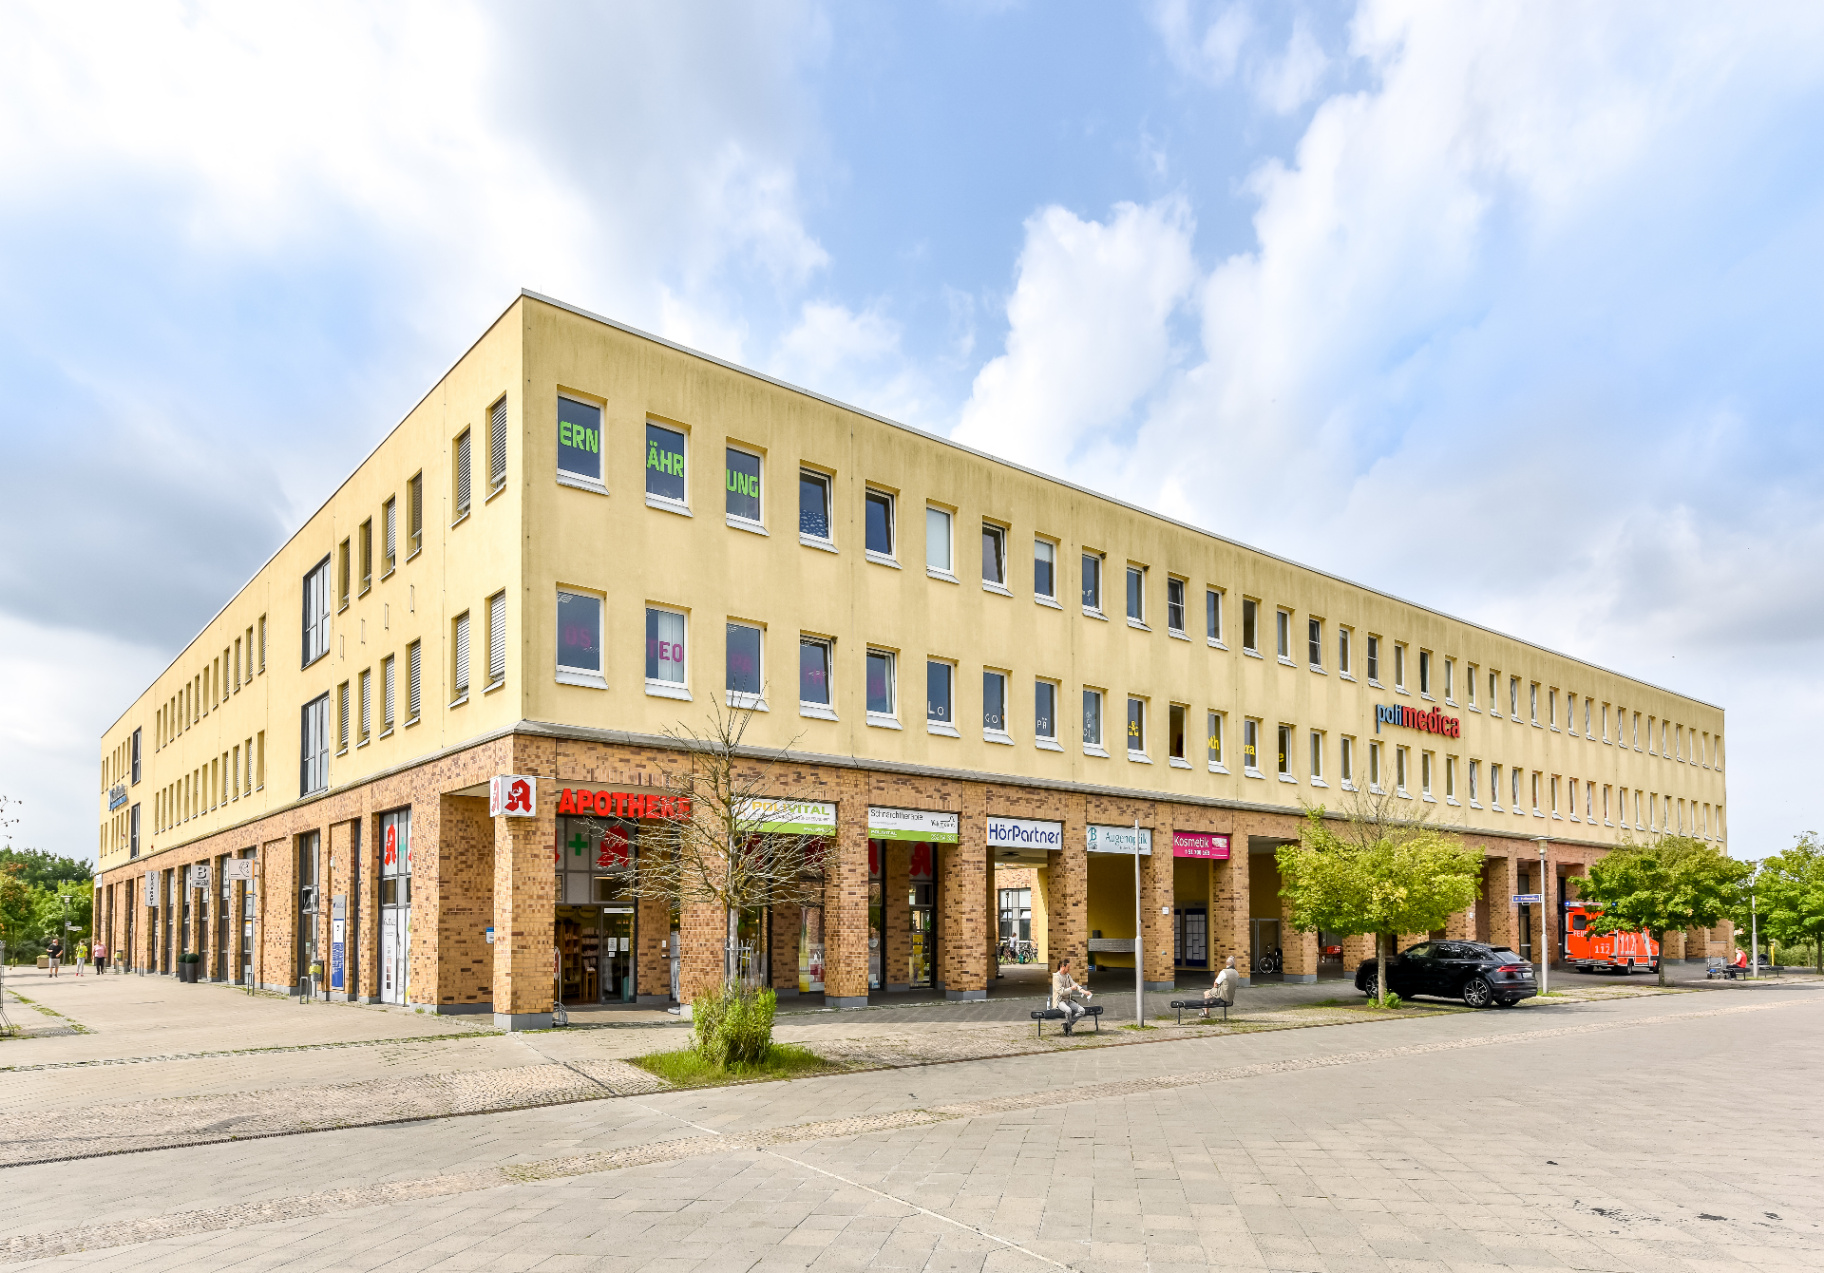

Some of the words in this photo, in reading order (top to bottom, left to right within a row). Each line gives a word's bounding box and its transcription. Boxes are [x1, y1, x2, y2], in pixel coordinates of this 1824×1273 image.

[559, 420, 599, 454] ERN
[646, 440, 684, 478] ÄHR
[726, 468, 759, 499] UNG
[1376, 704, 1460, 738] polimedica
[558, 788, 692, 821] APOTHEKE
[989, 823, 1060, 844] HörPartner
[1105, 831, 1148, 846] Augenopik
[1173, 834, 1210, 848] Kosmetik
[1594, 945, 1610, 954] 112
